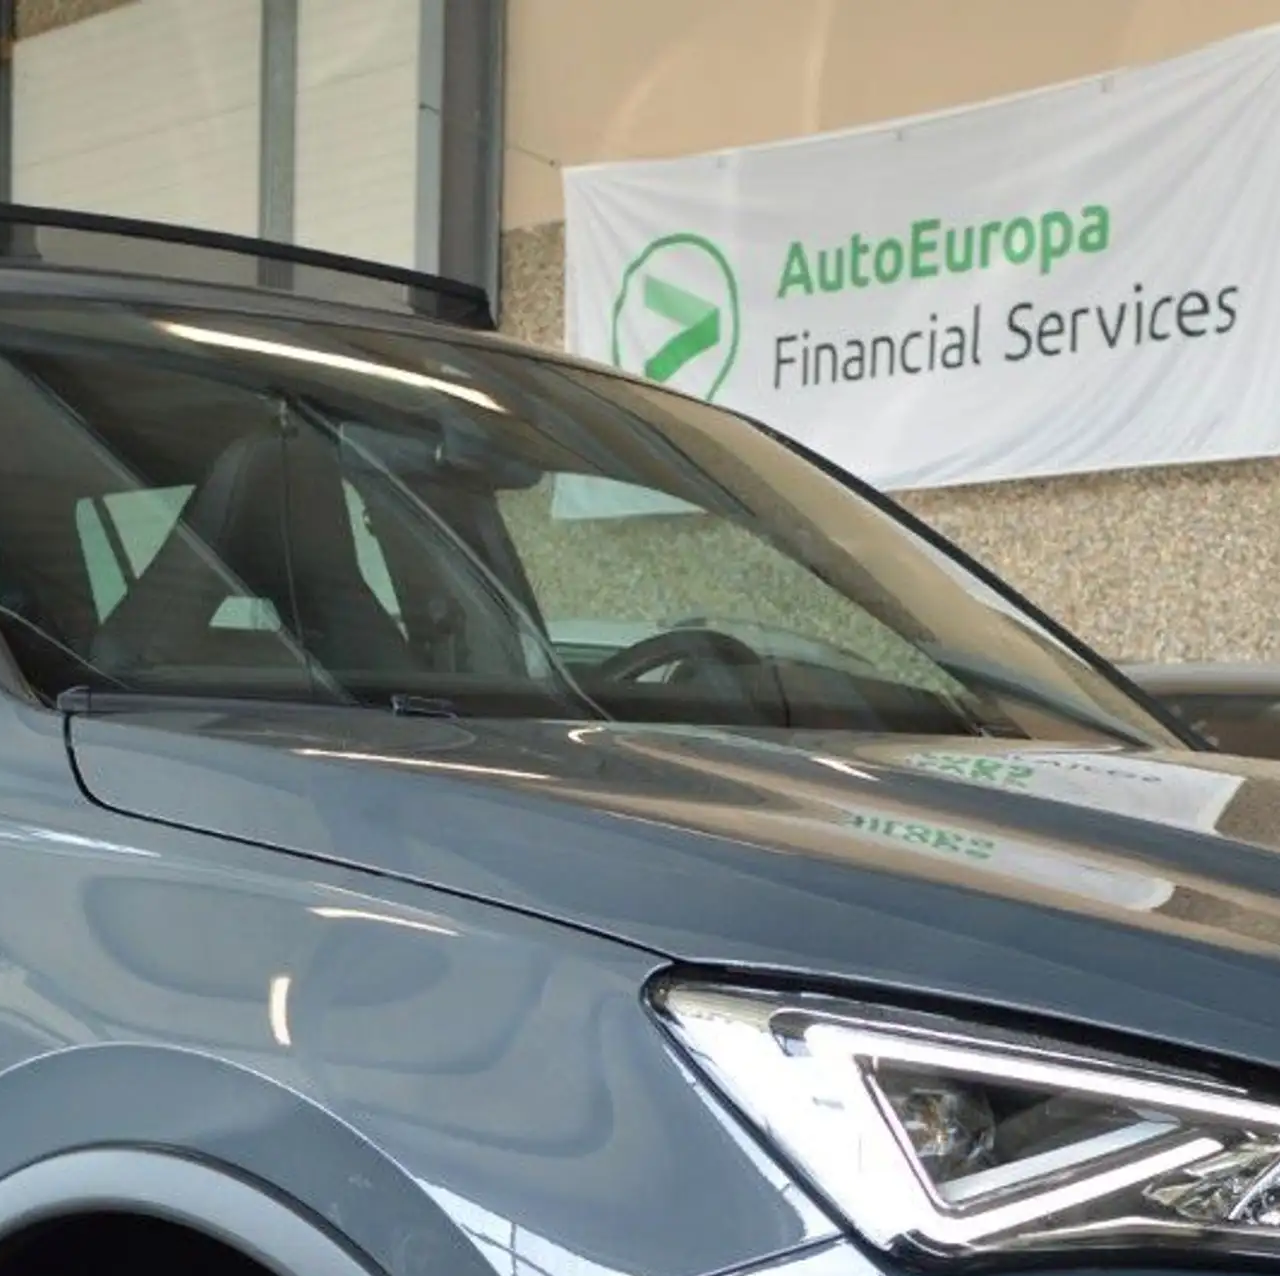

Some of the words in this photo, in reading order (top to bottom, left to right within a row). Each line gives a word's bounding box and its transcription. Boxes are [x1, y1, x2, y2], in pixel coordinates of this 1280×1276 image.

[777, 203, 1110, 299] AutoEuropa
[774, 302, 982, 389] Financial
[1004, 282, 1239, 361] Services
